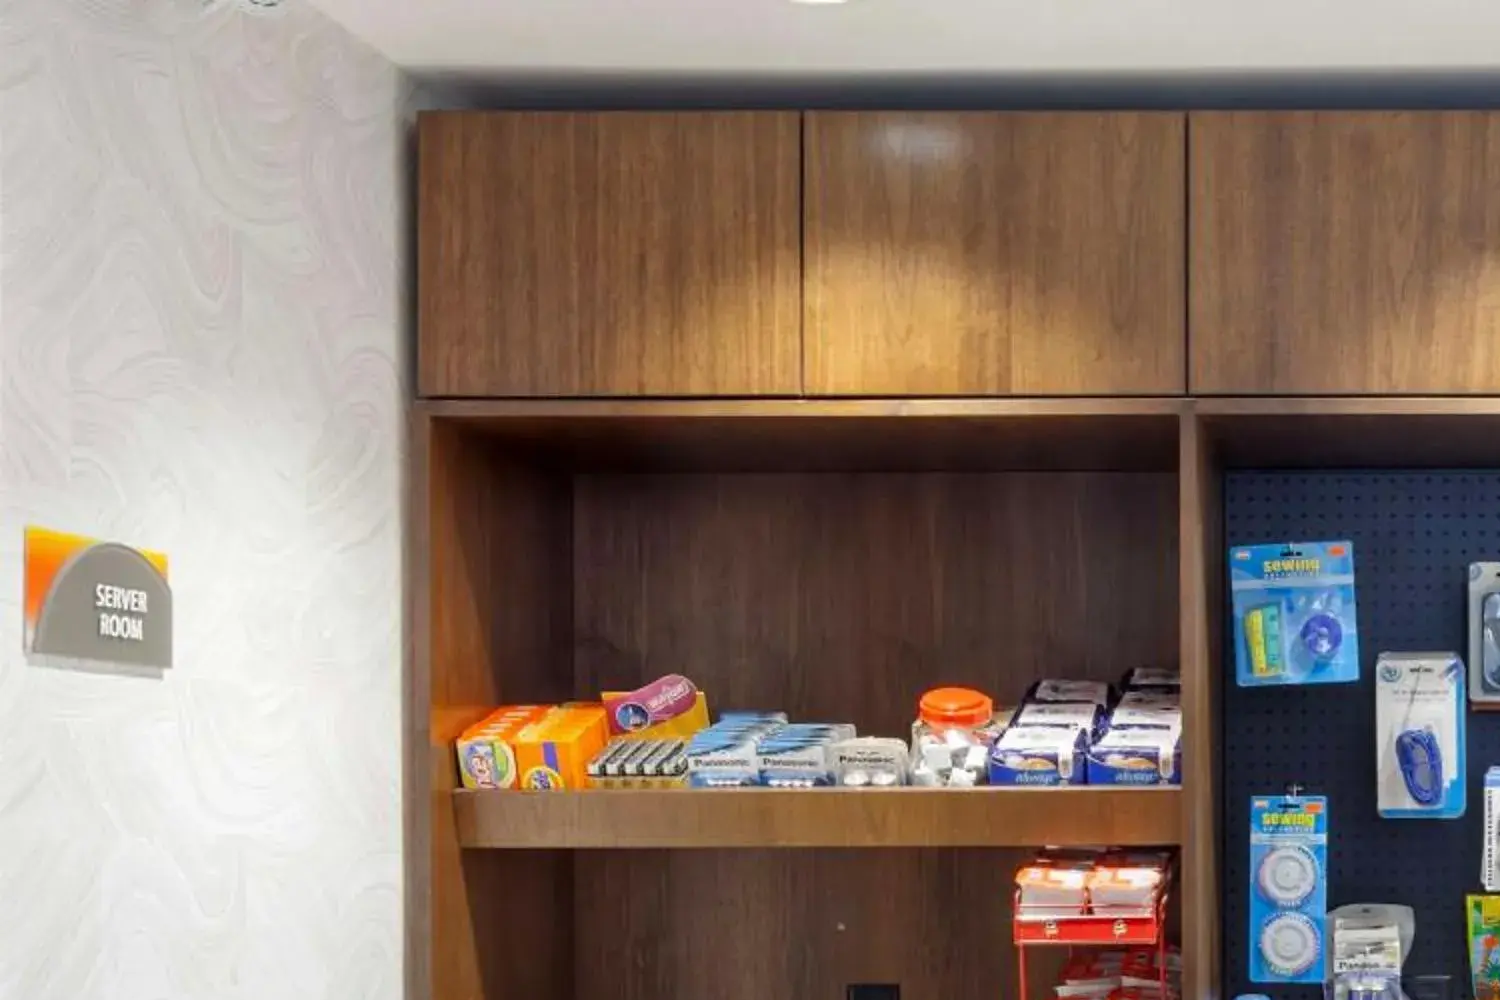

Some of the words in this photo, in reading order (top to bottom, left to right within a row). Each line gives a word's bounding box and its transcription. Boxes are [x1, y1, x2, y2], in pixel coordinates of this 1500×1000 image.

[95, 584, 147, 613] SERVER
[100, 613, 143, 640] ROOM
[693, 758, 750, 768] Panasonic
[762, 758, 820, 768] Panasonic
